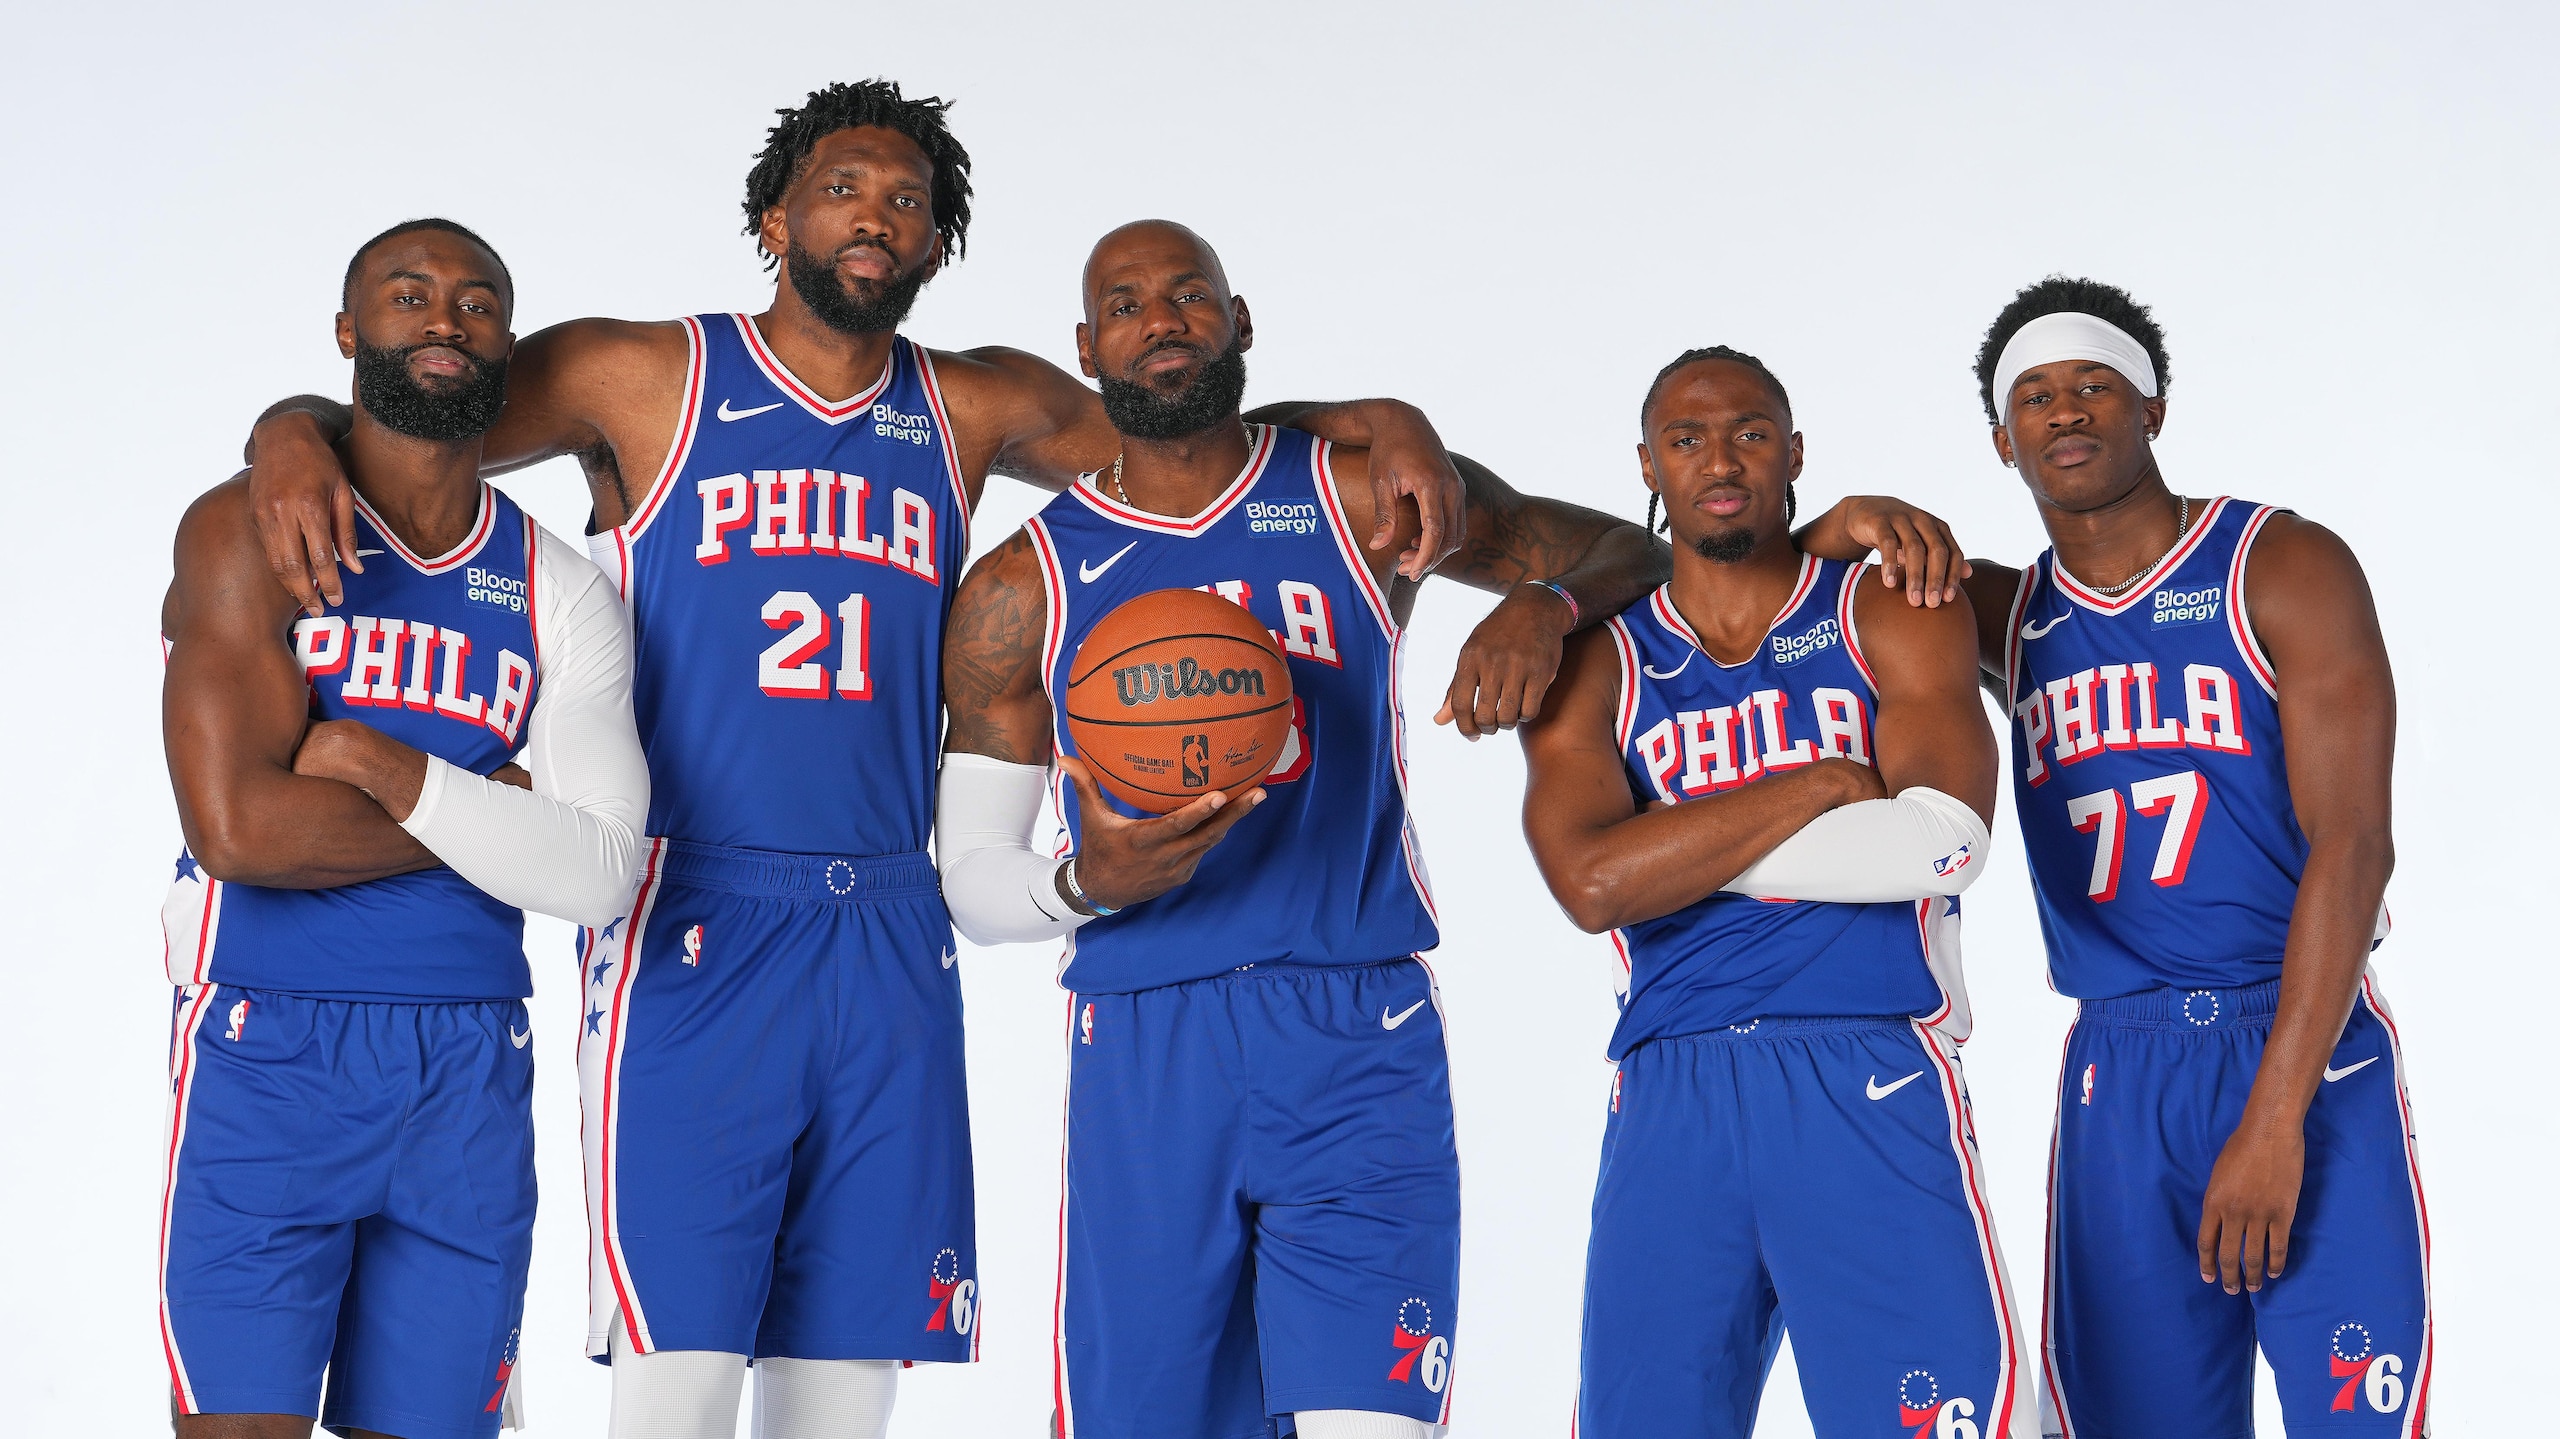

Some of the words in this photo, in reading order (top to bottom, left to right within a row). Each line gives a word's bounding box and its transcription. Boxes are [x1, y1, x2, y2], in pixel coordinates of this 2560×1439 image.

[872, 404, 930, 428] Bloom
[875, 423, 931, 446] energy
[1245, 501, 1316, 519] Bloom
[1250, 518, 1317, 534] energy
[695, 468, 940, 587] PHILA
[466, 567, 528, 596] Bloom
[2154, 587, 2221, 610] Bloom
[467, 587, 528, 614] energy
[2153, 602, 2220, 624] energy
[758, 590, 873, 701] 21
[1772, 618, 1838, 652] Bloom
[1774, 630, 1839, 664] energy
[293, 615, 534, 751] PHILA
[1112, 657, 1266, 707] Wilson
[2016, 662, 2252, 789] PHILA
[1635, 687, 1875, 805] PHILA
[1162, 759, 1175, 768] BALL
[1185, 777, 1200, 786] NBA
[2067, 770, 2210, 904] 77
[925, 1275, 976, 1335] 76
[1387, 1323, 1449, 1393] 76
[2330, 1352, 2405, 1414] 76
[1899, 1397, 1980, 1439] 76
